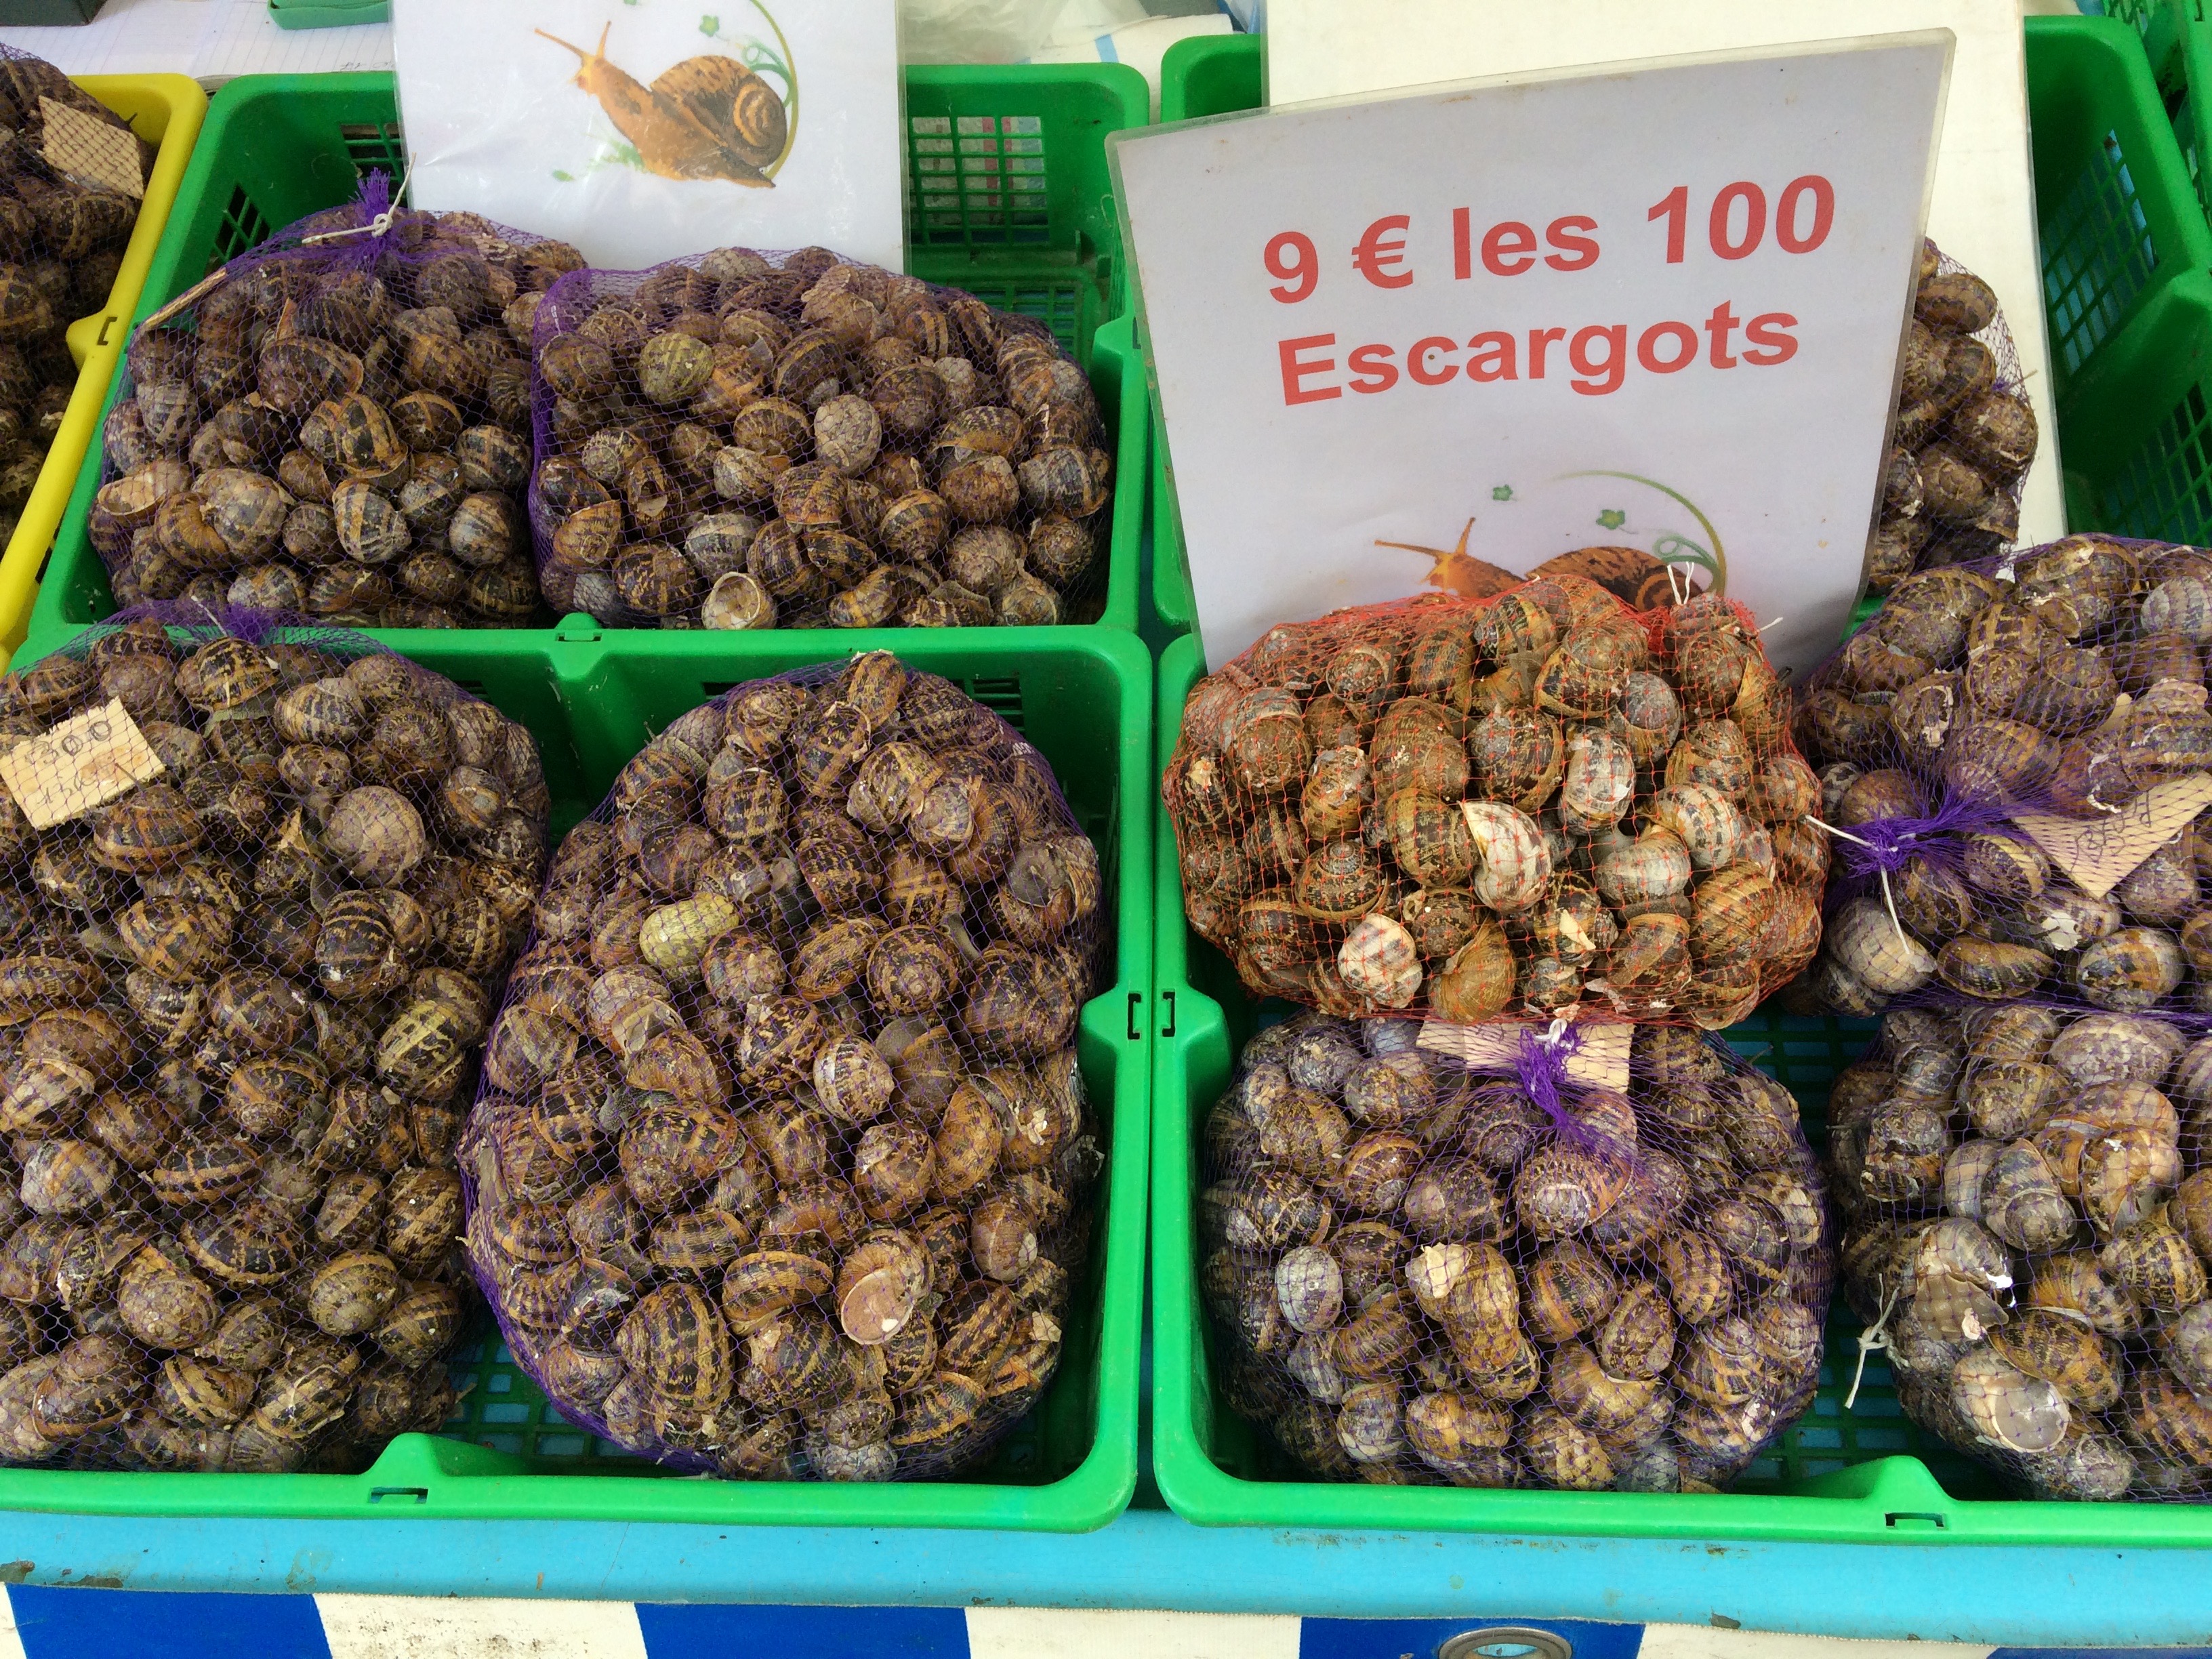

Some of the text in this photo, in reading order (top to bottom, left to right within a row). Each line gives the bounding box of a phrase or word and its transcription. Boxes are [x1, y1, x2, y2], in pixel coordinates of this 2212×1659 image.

[1264, 175, 1835, 304] 9 € les 100
[1278, 300, 1799, 407] Escargots
